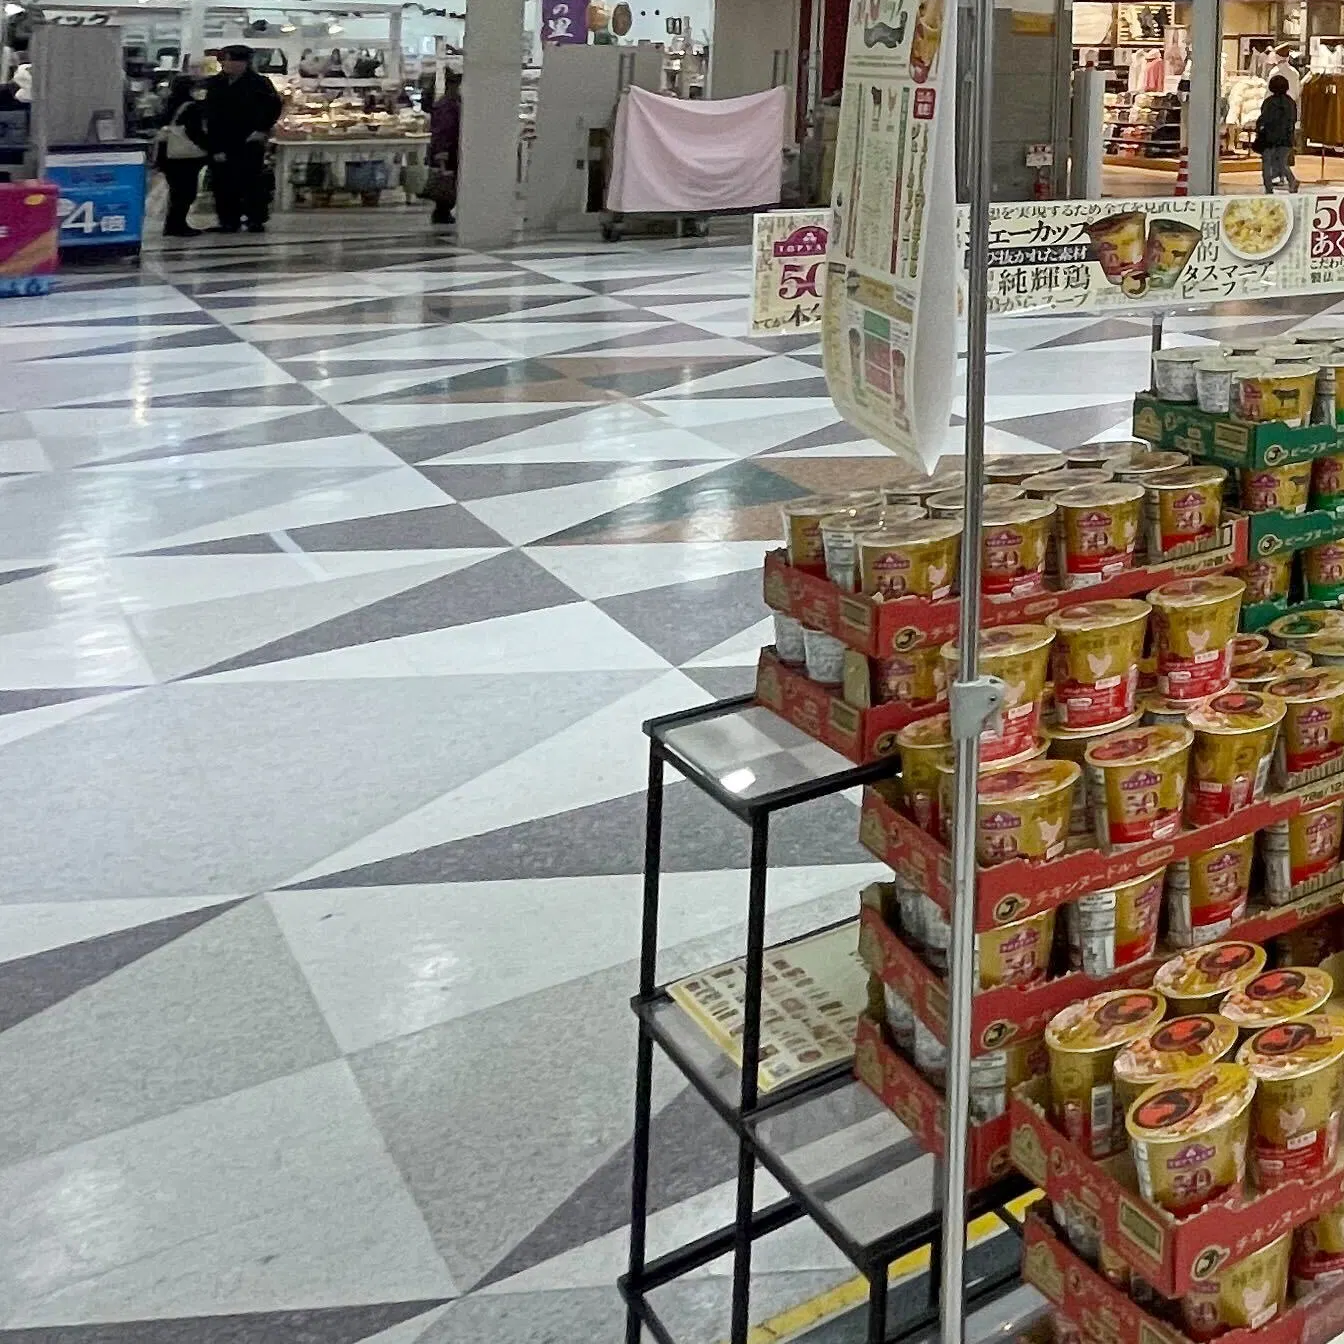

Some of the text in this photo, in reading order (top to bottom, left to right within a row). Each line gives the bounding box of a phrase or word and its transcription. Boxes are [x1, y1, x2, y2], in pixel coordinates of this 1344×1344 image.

[1200, 198, 1221, 263] 圧倒的
[1181, 280, 1238, 300] ビーフ
[1182, 260, 1275, 283] タスマニア
[1034, 862, 1133, 904] チキンヌードル
[1236, 1189, 1335, 1254] チキンヌードル
